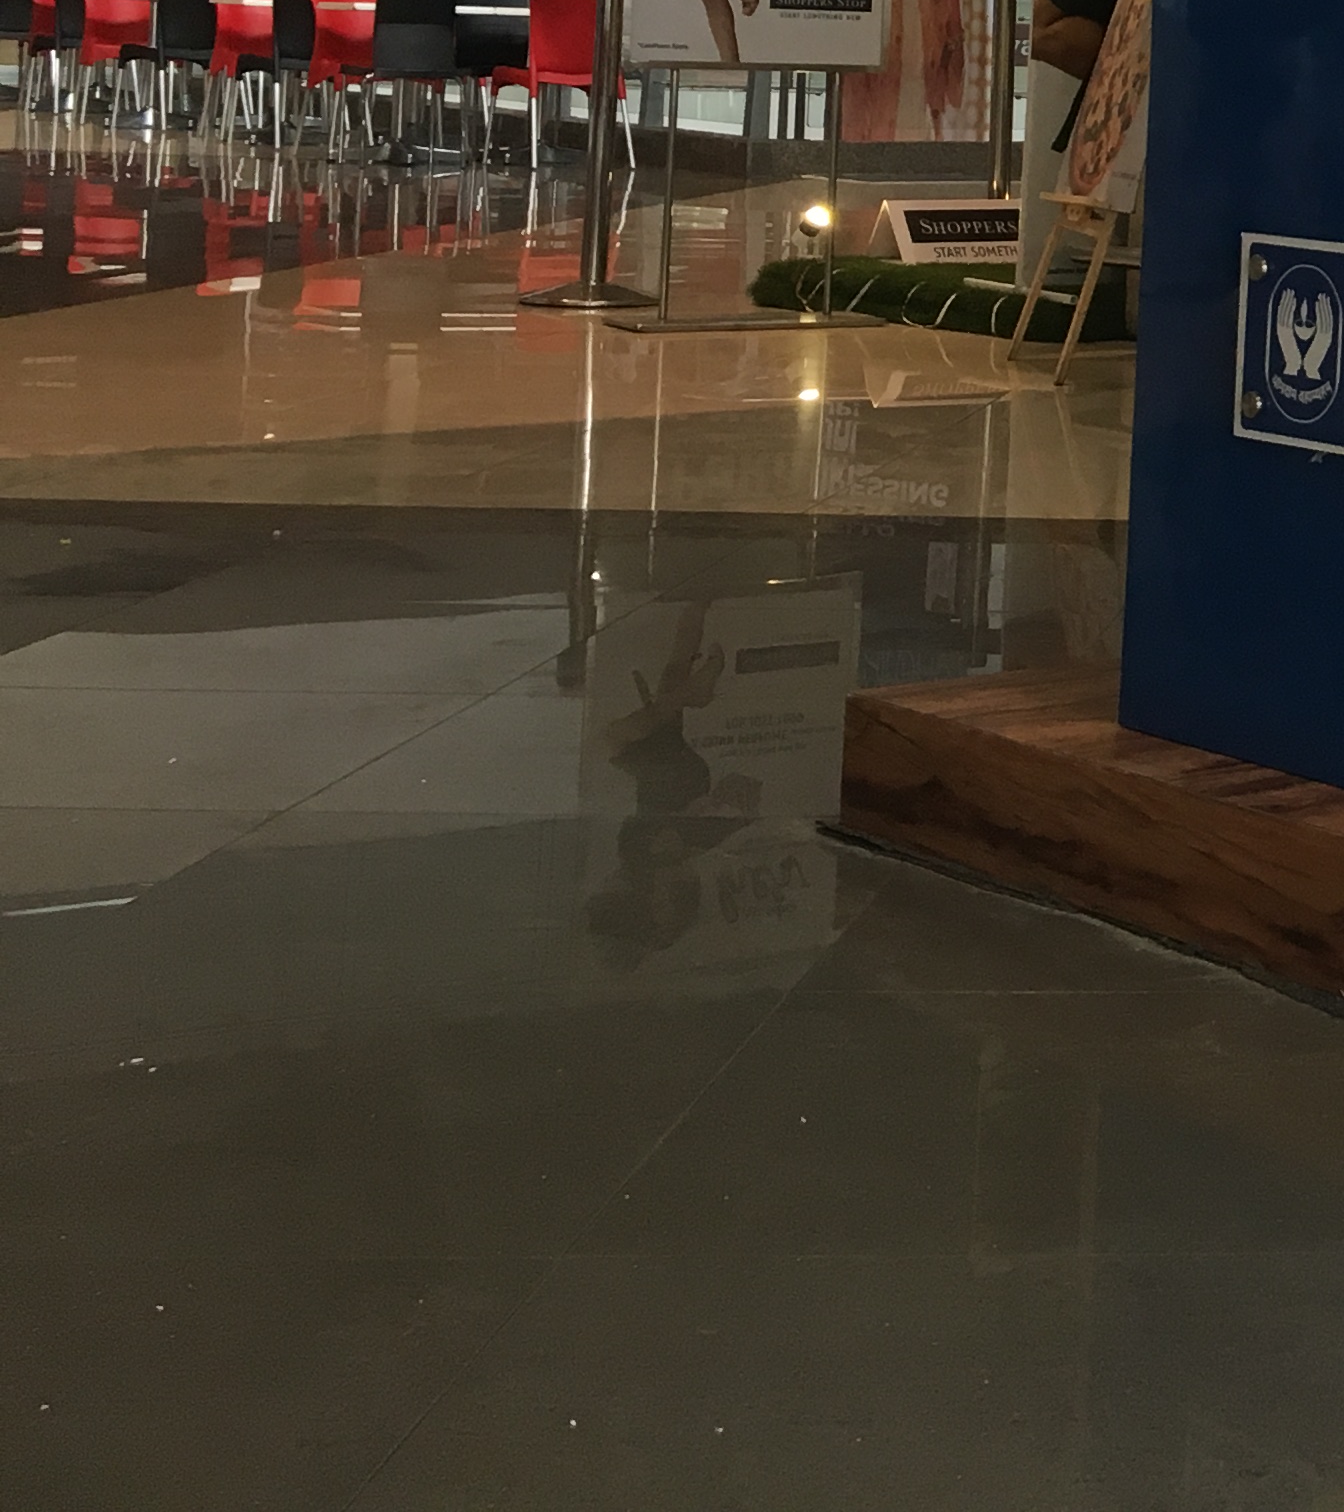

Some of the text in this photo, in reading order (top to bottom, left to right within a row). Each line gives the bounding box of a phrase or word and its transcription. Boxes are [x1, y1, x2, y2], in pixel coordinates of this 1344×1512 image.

[919, 217, 1017, 236] SHOPPERS
[934, 245, 1018, 258] START SOMETH
